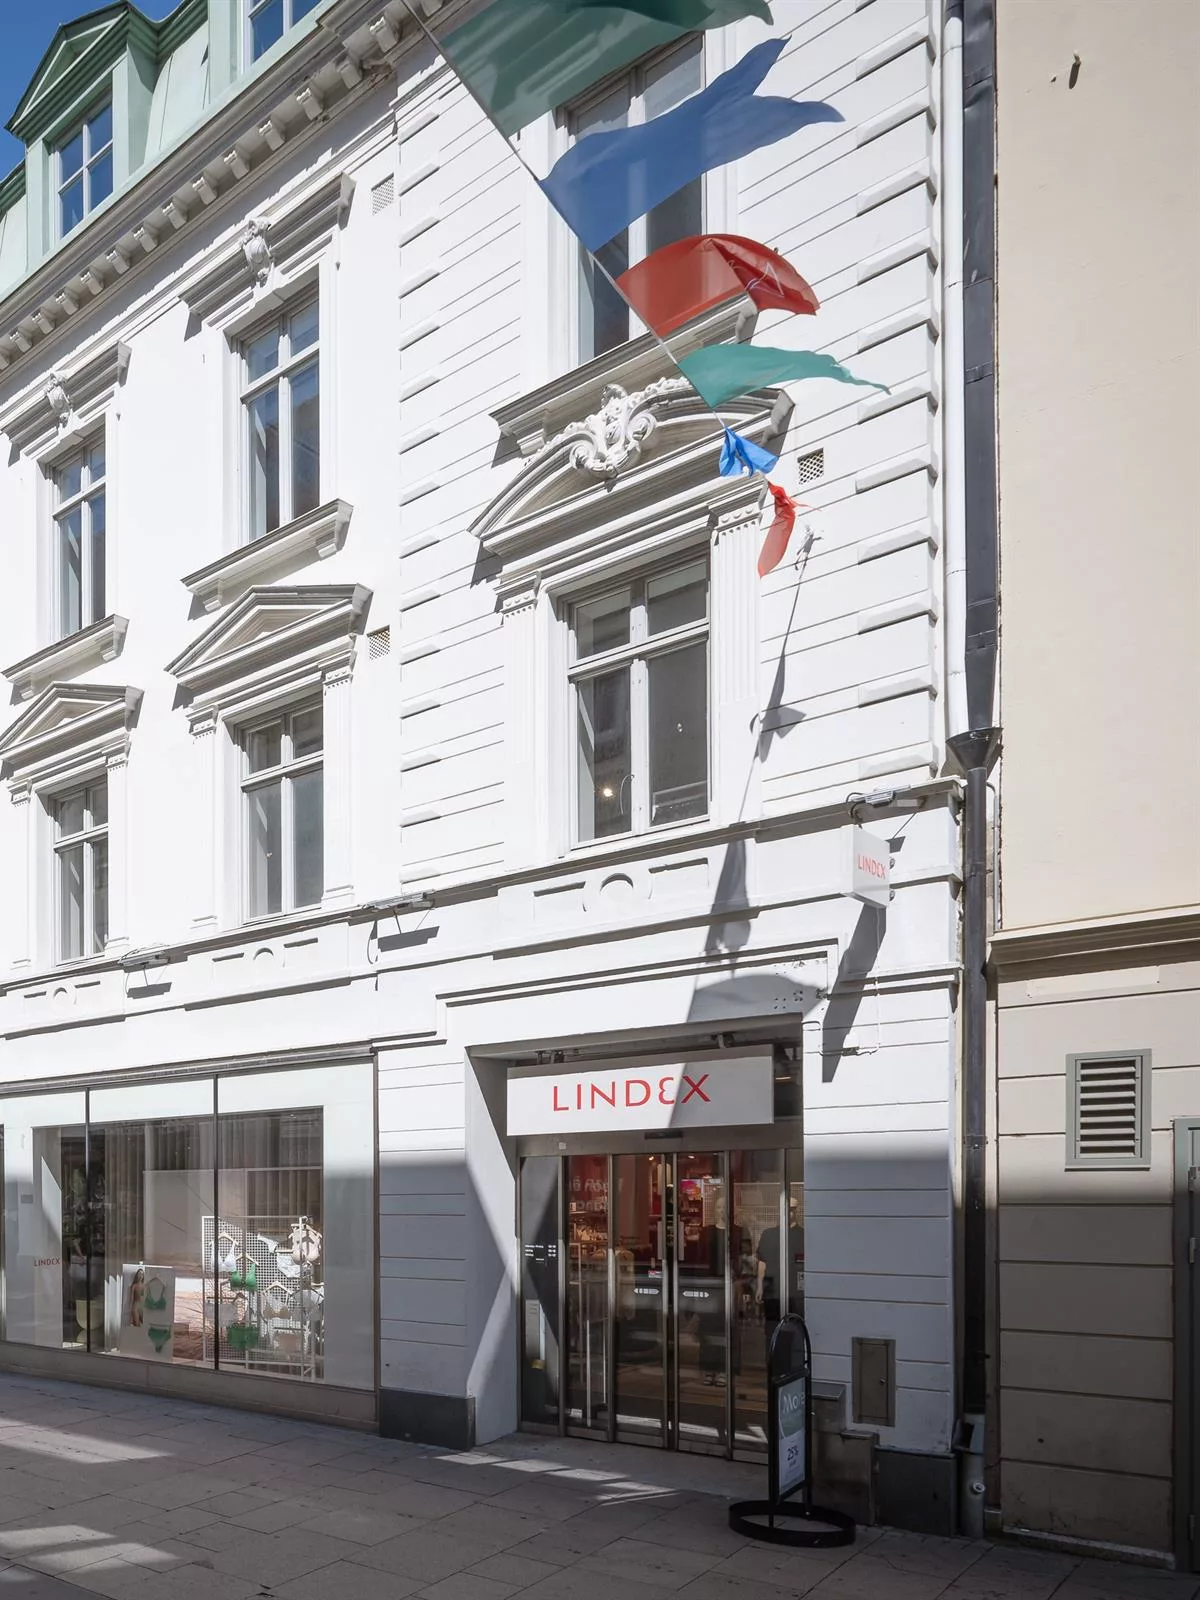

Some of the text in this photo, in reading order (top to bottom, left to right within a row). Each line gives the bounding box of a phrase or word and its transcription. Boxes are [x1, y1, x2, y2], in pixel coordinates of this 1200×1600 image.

[857, 853, 887, 880] LINDEX
[553, 1074, 711, 1111] LINDEX
[33, 1258, 61, 1267] LINDEX
